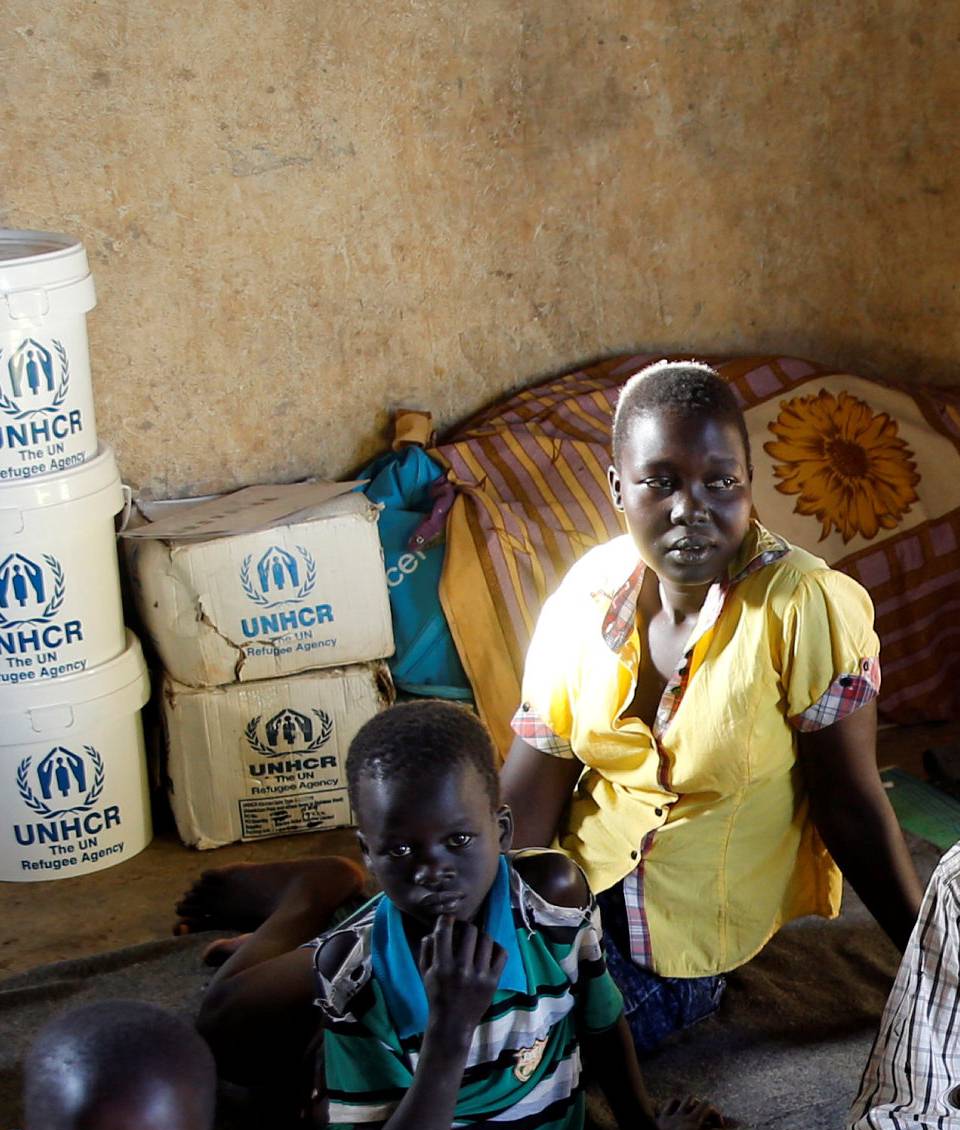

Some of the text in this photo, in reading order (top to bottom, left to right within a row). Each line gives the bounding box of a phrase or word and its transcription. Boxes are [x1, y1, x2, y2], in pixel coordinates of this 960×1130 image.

[0, 409, 82, 449] NHCR
[18, 443, 65, 461] The UN
[50, 451, 86, 470] Agency
[241, 603, 334, 638] UNHCR
[295, 630, 313, 641] UN
[247, 638, 337, 656] Refugee Agency
[6, 651, 57, 668] The UN
[0, 660, 87, 683] ugee Agency
[249, 756, 337, 776] UNHCR
[275, 771, 314, 783] The UN
[251, 778, 339, 795] Refugee Agency
[14, 806, 120, 845] UNHCR
[49, 837, 98, 855] The UN
[21, 842, 124, 870] Refugee Agency
